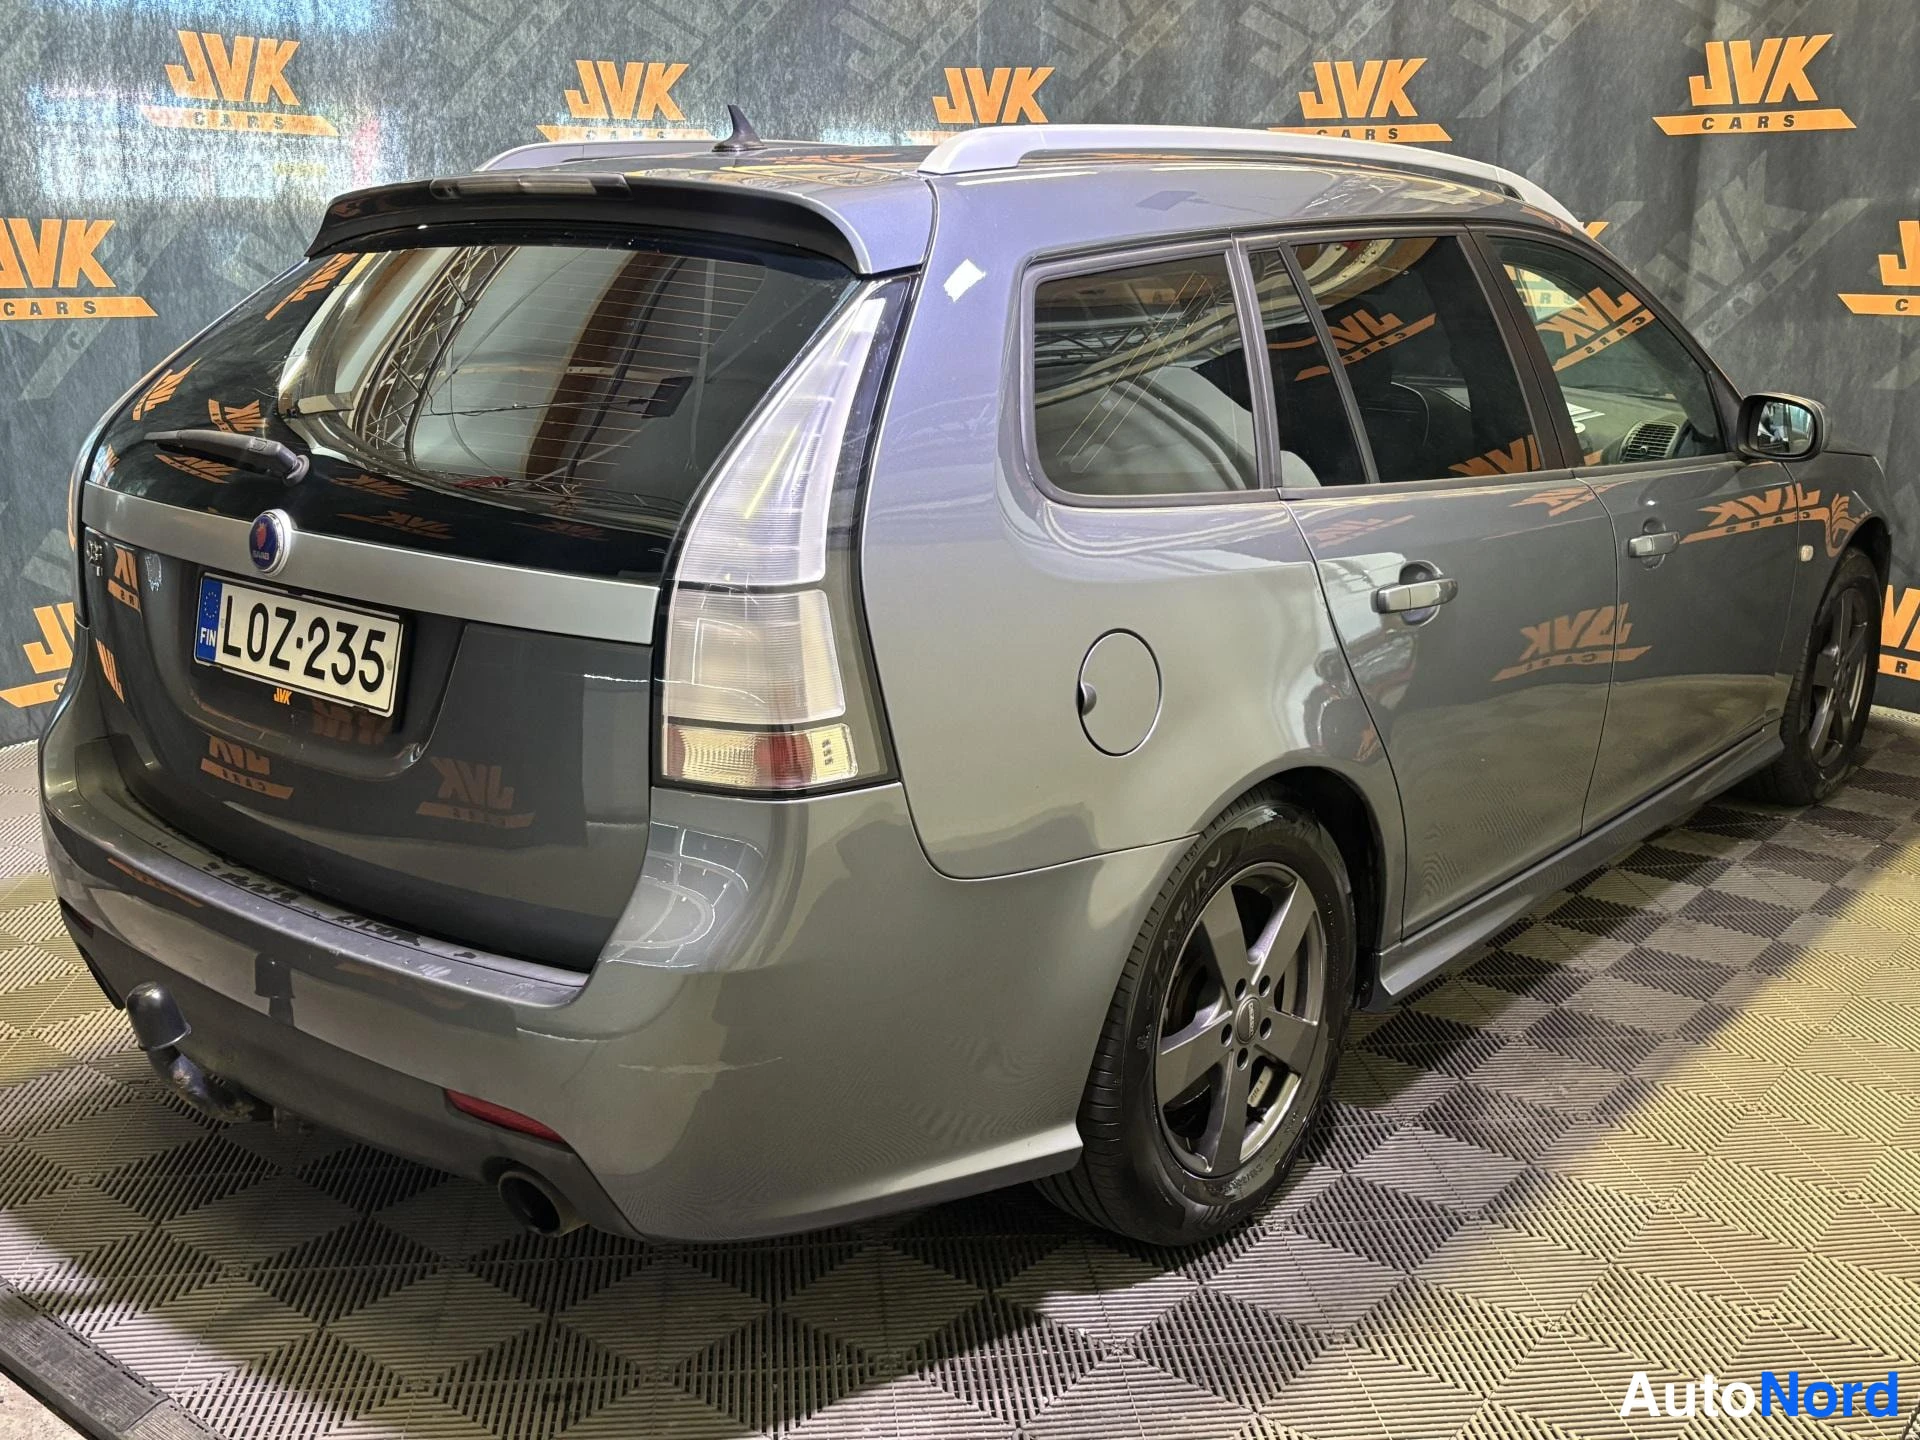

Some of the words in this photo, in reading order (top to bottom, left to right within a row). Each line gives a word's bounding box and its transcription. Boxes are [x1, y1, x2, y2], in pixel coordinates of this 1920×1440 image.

[165, 30, 300, 106] JVK
[564, 59, 690, 121] JVK
[932, 67, 1055, 124] JVK
[1298, 57, 1428, 119] JVK
[1688, 33, 1834, 107] JVK
[193, 111, 286, 130] CARS
[1701, 114, 1796, 130] CARS
[3, 300, 97, 317] CARS
[200, 627, 217, 648] FIN
[222, 595, 387, 693] LOZ-235
[273, 687, 293, 706] JVK
